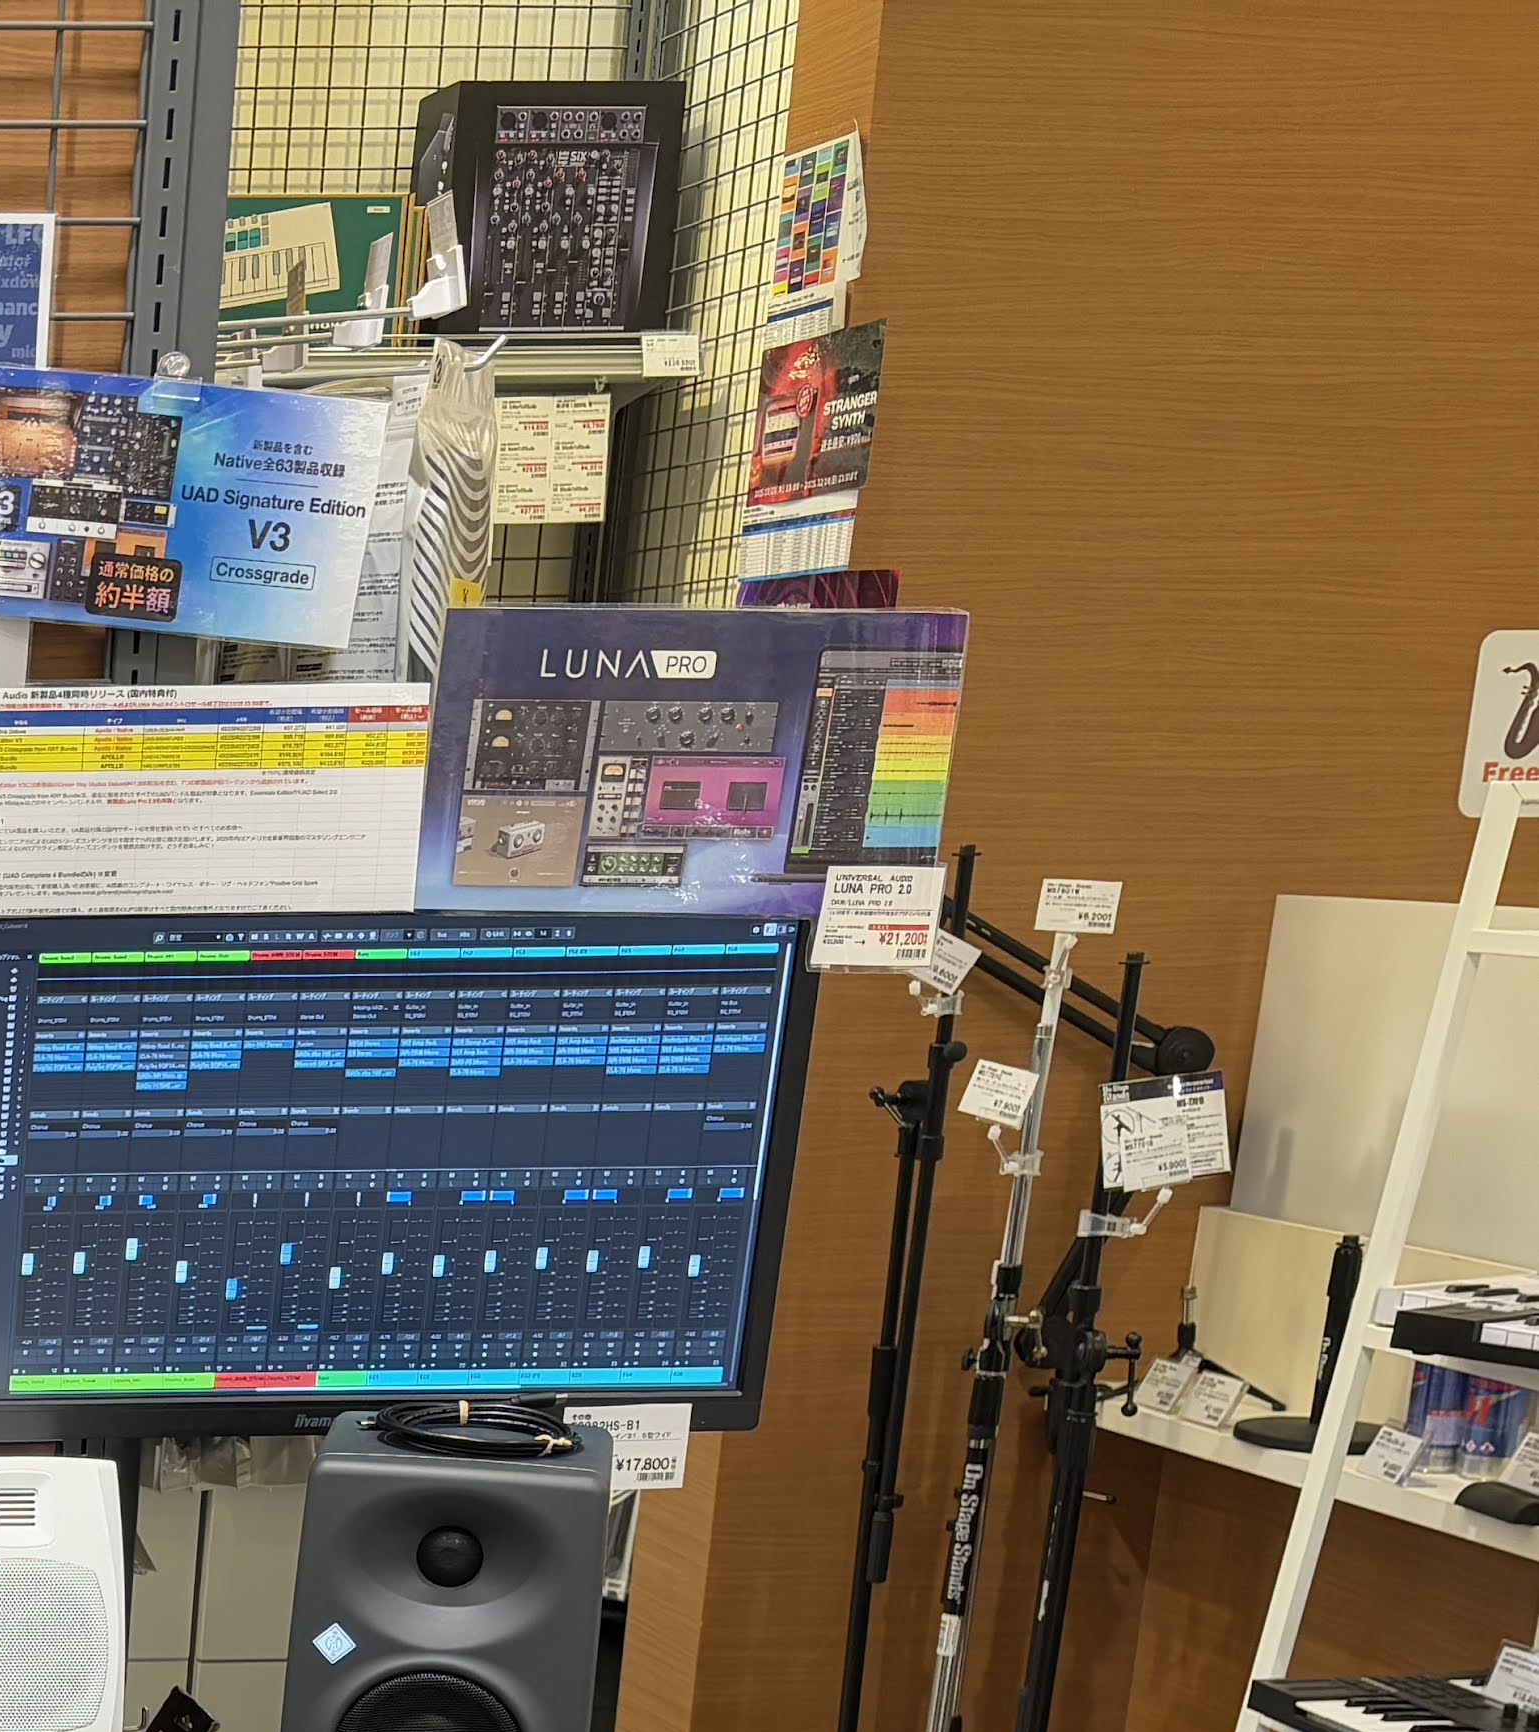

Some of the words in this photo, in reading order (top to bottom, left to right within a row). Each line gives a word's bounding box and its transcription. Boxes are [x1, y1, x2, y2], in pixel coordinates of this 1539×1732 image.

[823, 391, 878, 416] STRANGER
[831, 411, 866, 430] SYNTH
[253, 439, 314, 457] 新製品を含む
[214, 452, 345, 478] Native全63製品収録
[181, 485, 220, 503] UAD
[222, 489, 305, 513] Signature
[309, 497, 367, 519] Edition
[247, 519, 292, 554] V3
[98, 559, 175, 585] 通常価格の
[216, 562, 310, 586] Crossgrade
[94, 581, 172, 615] 約半額
[539, 649, 651, 680] LUNA
[665, 655, 708, 674] PRO
[833, 882, 864, 895] LUNA
[869, 883, 893, 895] PRO
[835, 874, 883, 883] UNIVERSAL
[889, 874, 913, 883] AUDIO
